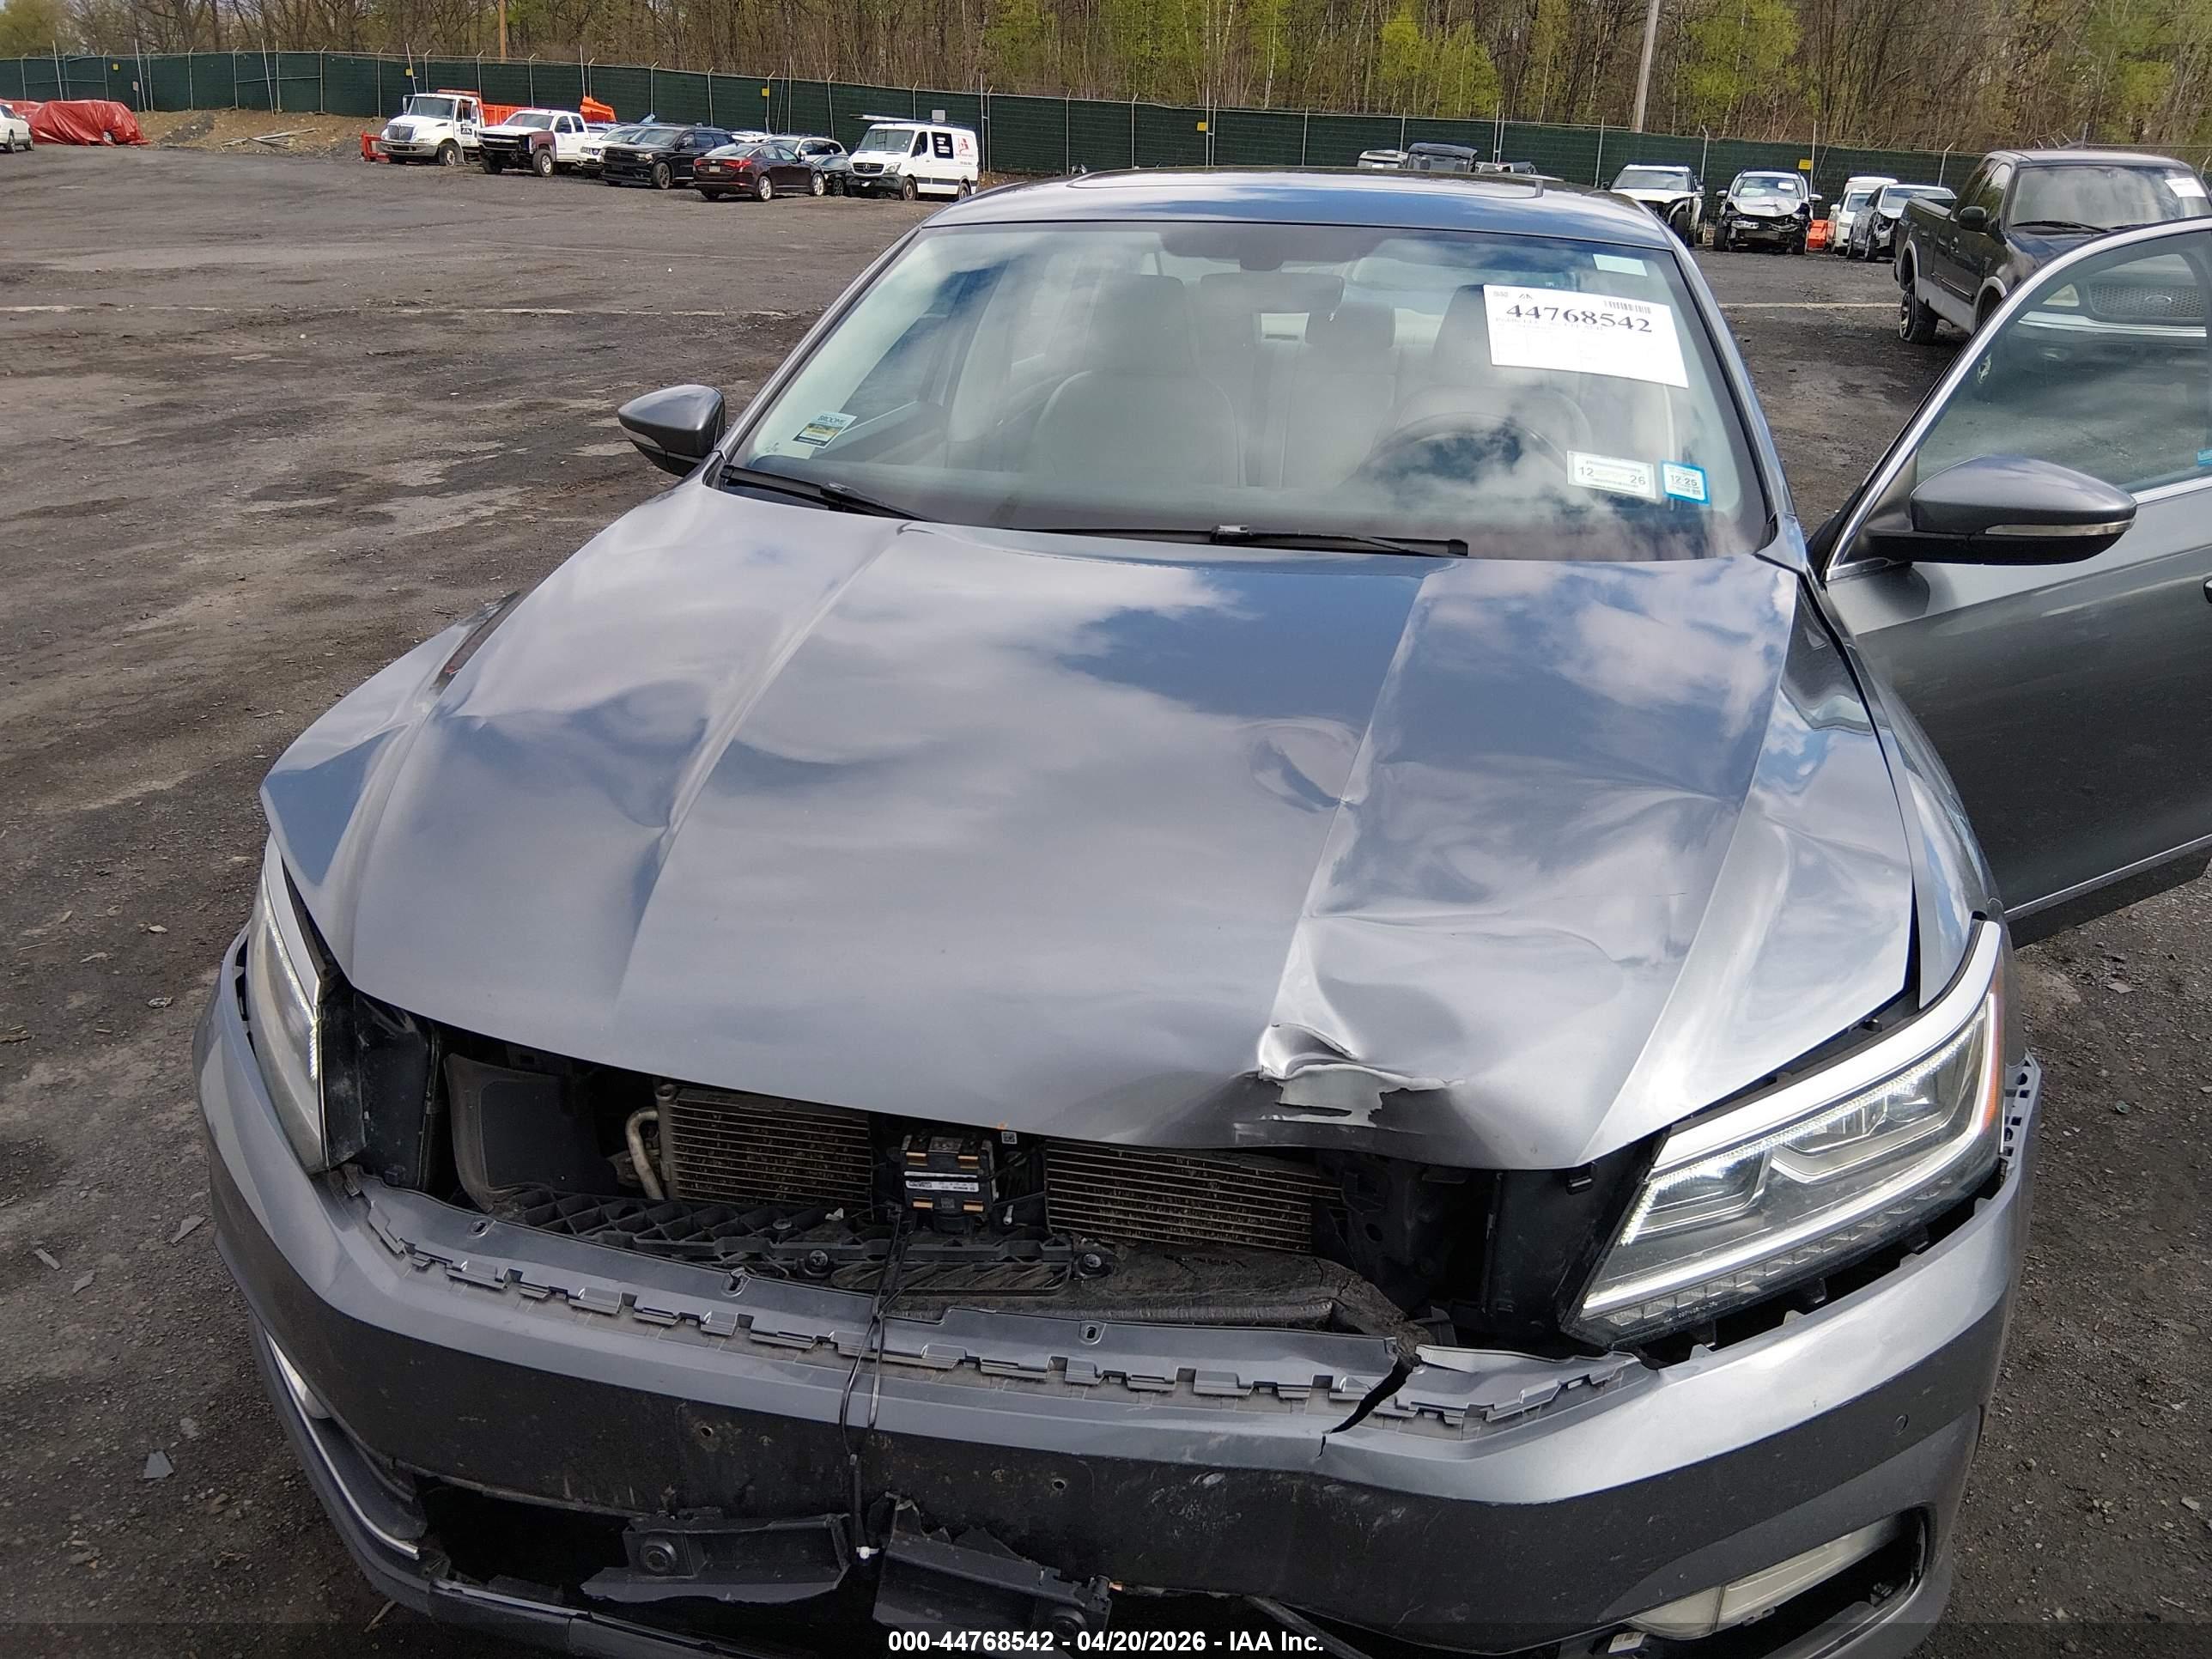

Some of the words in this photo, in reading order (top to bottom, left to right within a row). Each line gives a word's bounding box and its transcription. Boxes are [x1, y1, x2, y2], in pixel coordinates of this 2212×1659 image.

[1506, 304, 1652, 333] 44768542
[1578, 466, 1595, 477] 12
[1629, 474, 1646, 486] 26
[1670, 474, 1681, 483] 12
[1684, 477, 1698, 487] 25
